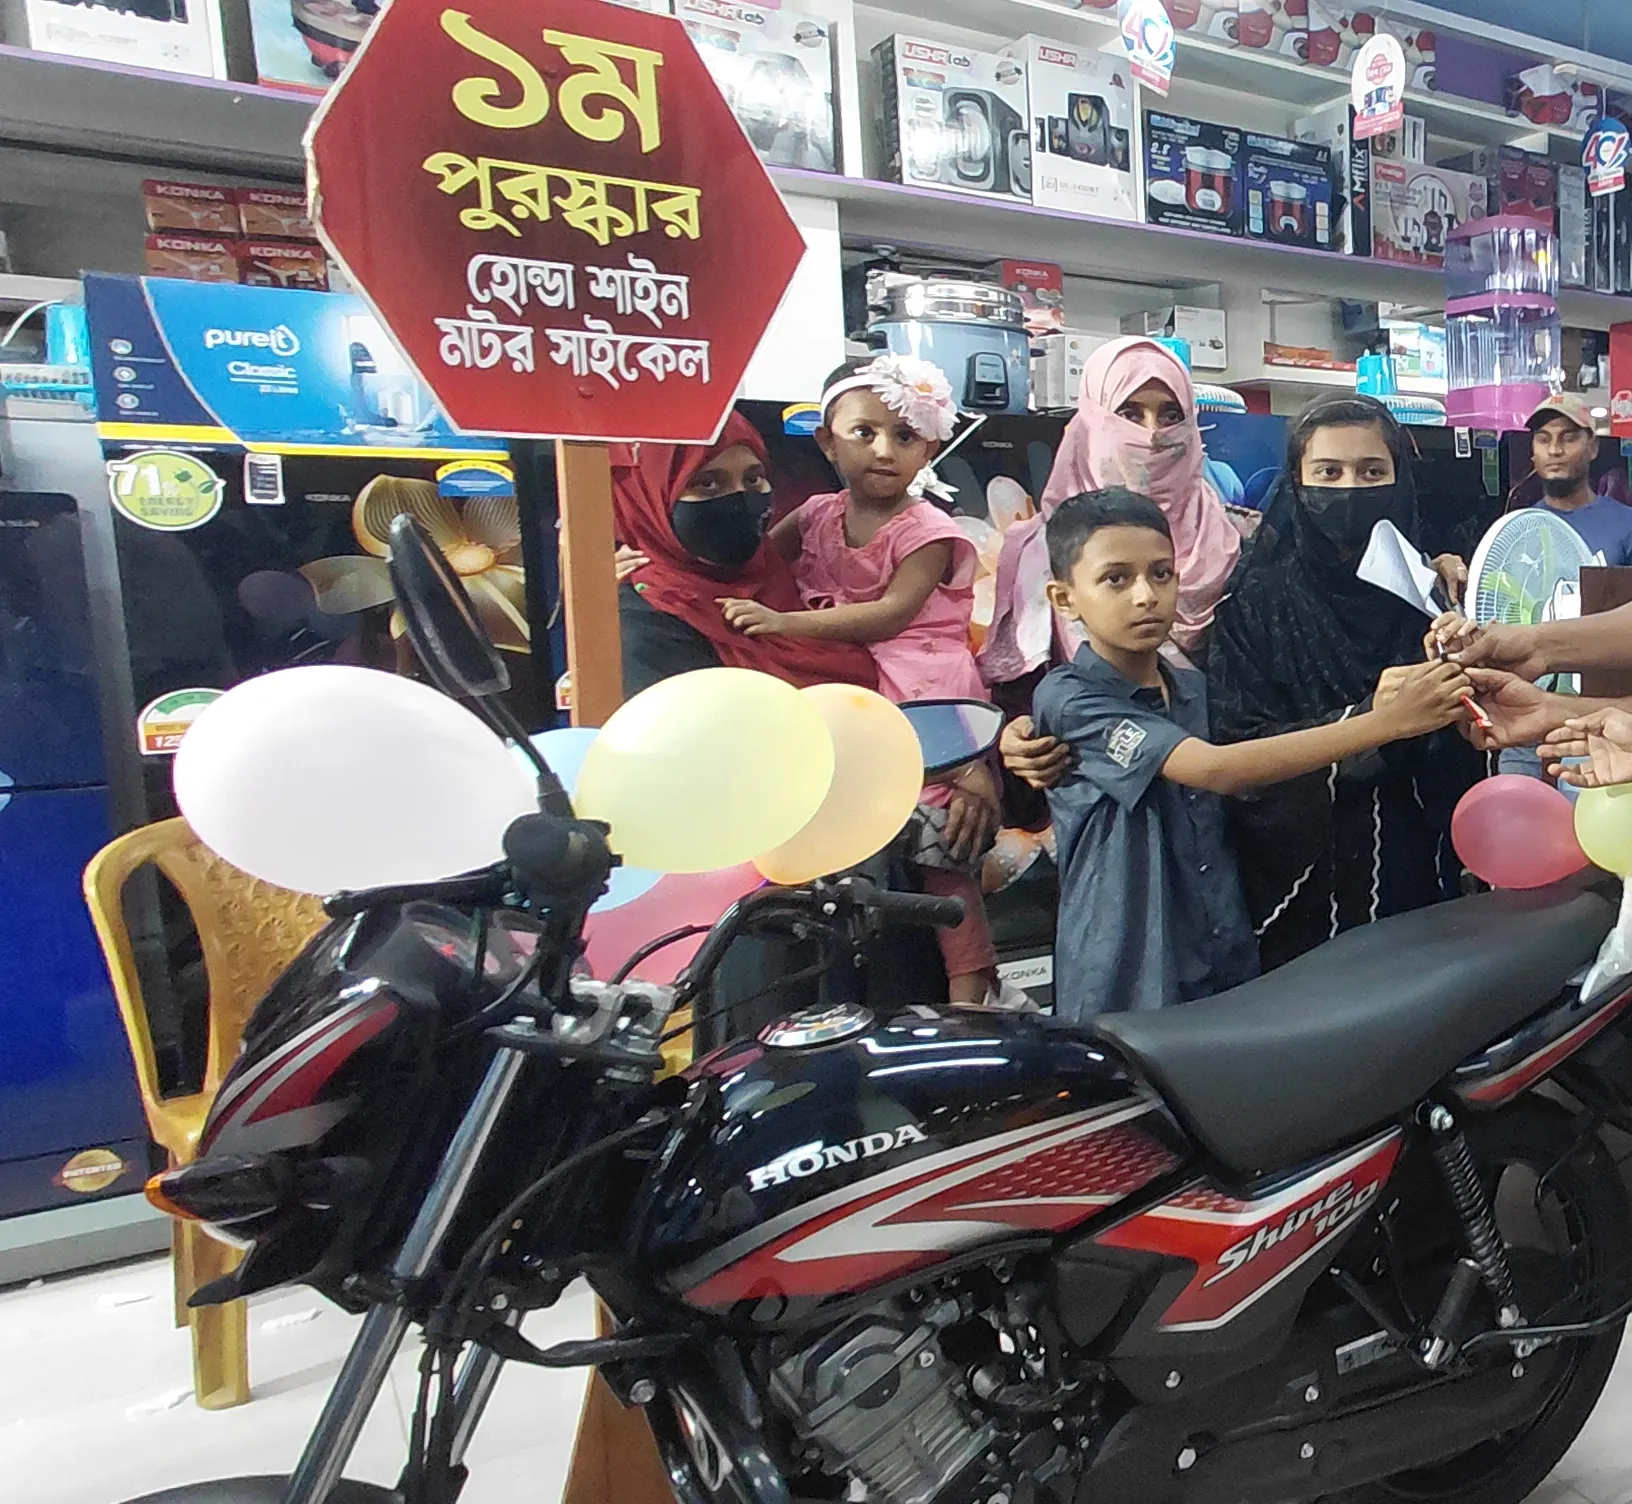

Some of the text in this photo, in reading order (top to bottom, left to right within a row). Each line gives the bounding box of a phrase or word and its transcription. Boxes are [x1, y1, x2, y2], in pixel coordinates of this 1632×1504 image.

[440, 9, 664, 153] ১ম
[156, 185, 225, 200] KONKA
[422, 152, 702, 246] পুরস্কার
[156, 239, 225, 253] KONKA
[250, 246, 315, 260] KONKA
[467, 252, 690, 330] হোন্ডা শাইন
[433, 303, 711, 391] মটর সাইকেল
[746, 1123, 929, 1193] HONDA
[1203, 1180, 1354, 1288] Shine
[1314, 1179, 1380, 1237] 100
